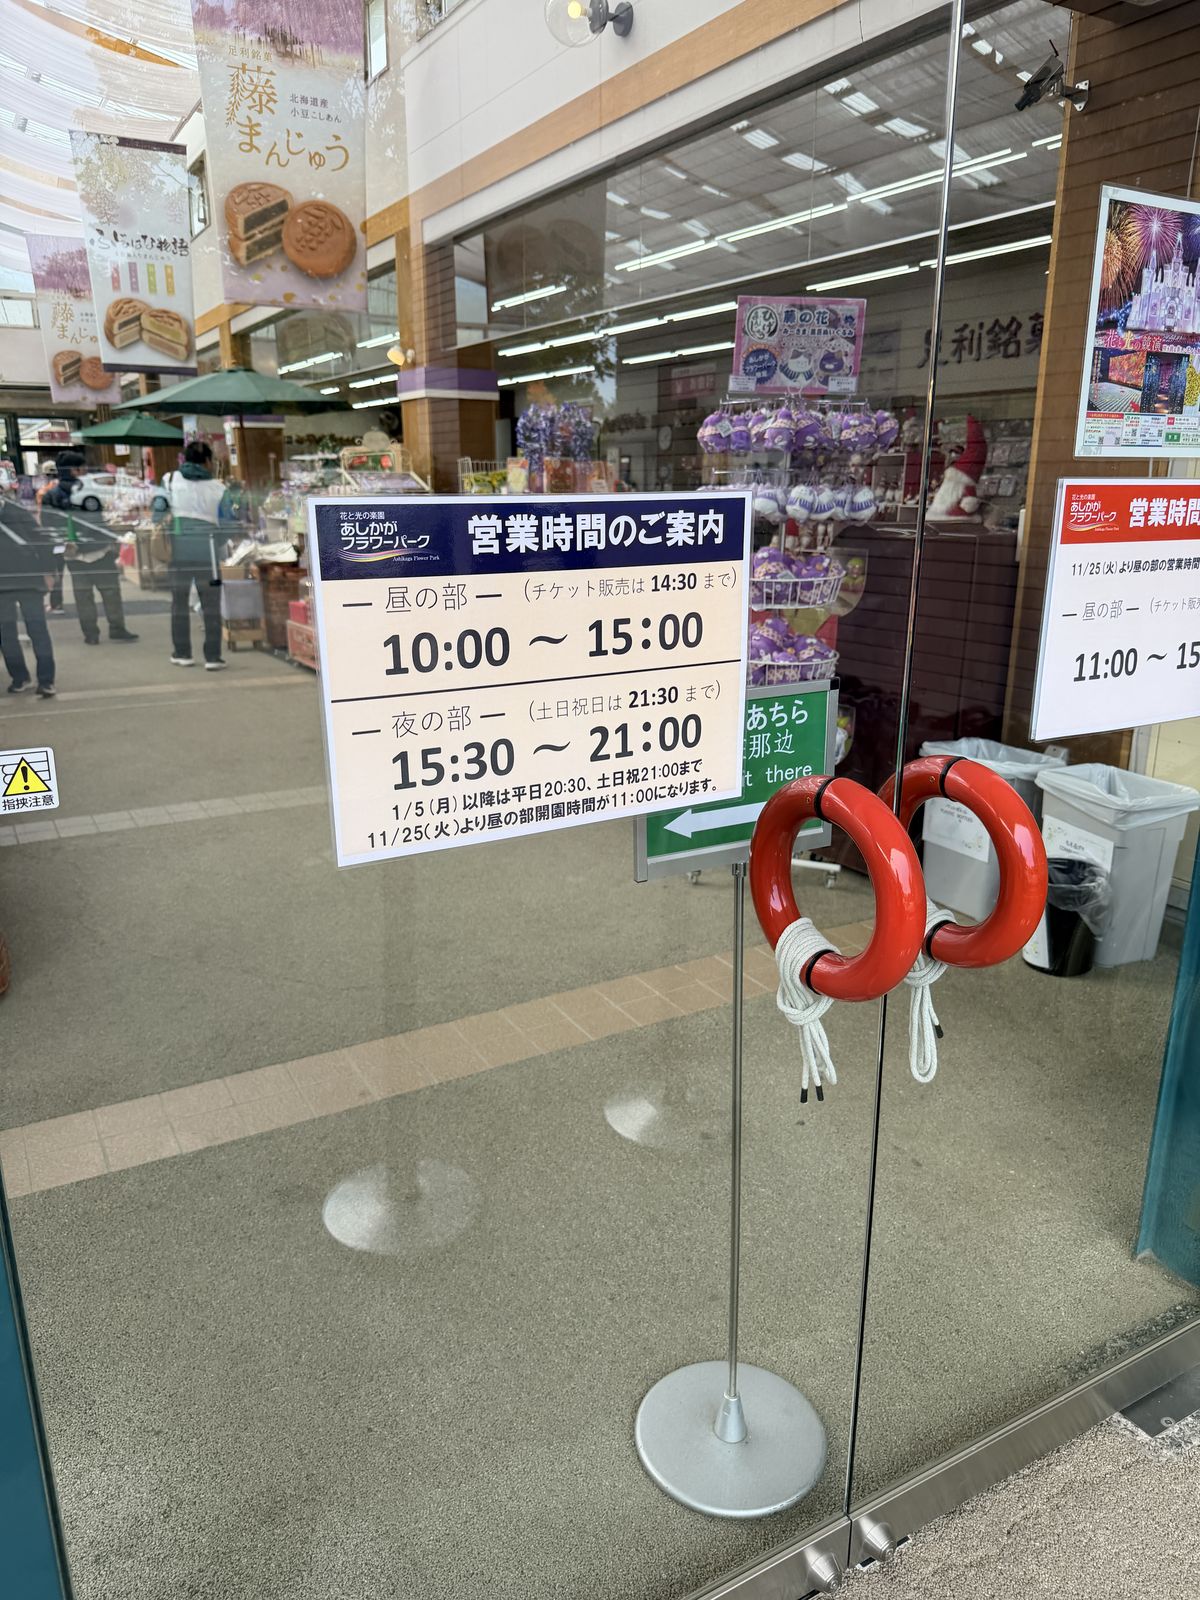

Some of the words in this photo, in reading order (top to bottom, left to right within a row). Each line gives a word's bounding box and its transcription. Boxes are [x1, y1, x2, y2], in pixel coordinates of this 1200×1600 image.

[289, 93, 329, 109] 北海道産
[290, 107, 342, 123] 小豆こしあん
[237, 115, 350, 171] まんじゅう
[339, 511, 386, 520] 花と光の楽園
[1070, 500, 1101, 512] あしかが
[1128, 497, 1200, 529] 営業時間
[1070, 511, 1118, 523] フラワーパーク
[340, 520, 398, 536] あしかが
[467, 509, 725, 555] 営業時間のご案内
[341, 534, 431, 551] フラワーパーク
[650, 572, 698, 592] 14:30
[383, 626, 511, 676] 10:00
[588, 611, 704, 658] 15:00
[1073, 648, 1138, 682] 11:00
[628, 686, 679, 709] 21:30
[392, 738, 516, 791] 15:30
[589, 713, 703, 763] 21:00
[765, 763, 813, 783] there
[2, 794, 55, 811] 指挟注意
